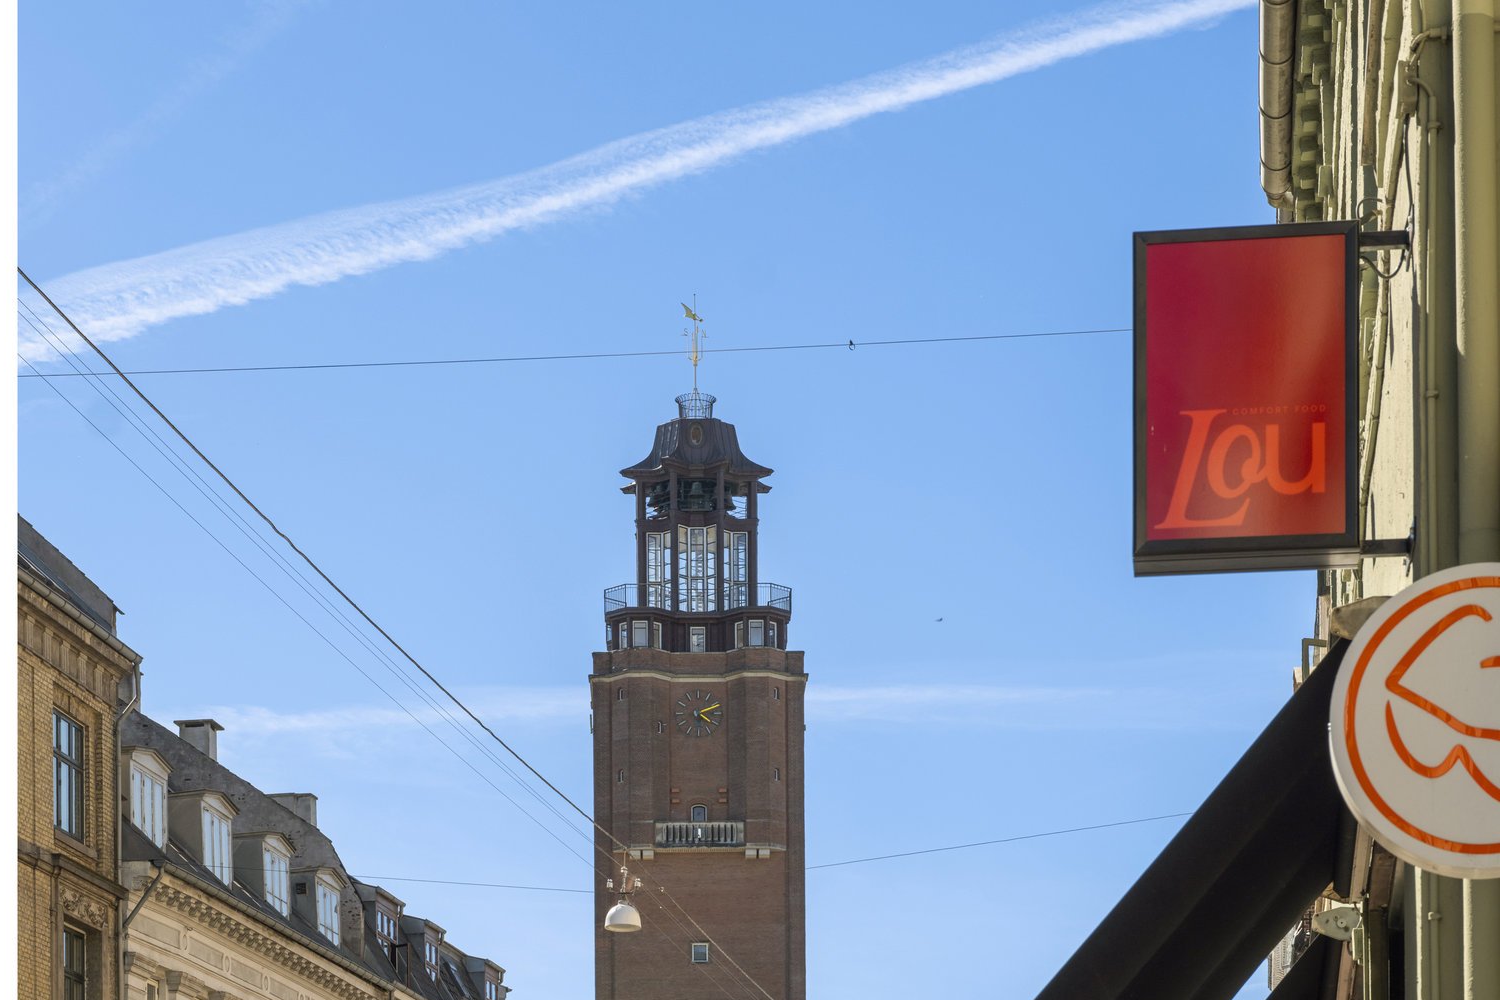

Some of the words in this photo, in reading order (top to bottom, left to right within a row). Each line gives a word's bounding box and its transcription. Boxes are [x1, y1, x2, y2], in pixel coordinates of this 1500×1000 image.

[1232, 406, 1290, 416] COMFORT
[1295, 403, 1327, 413] FOOD
[1153, 408, 1326, 530] Lou
